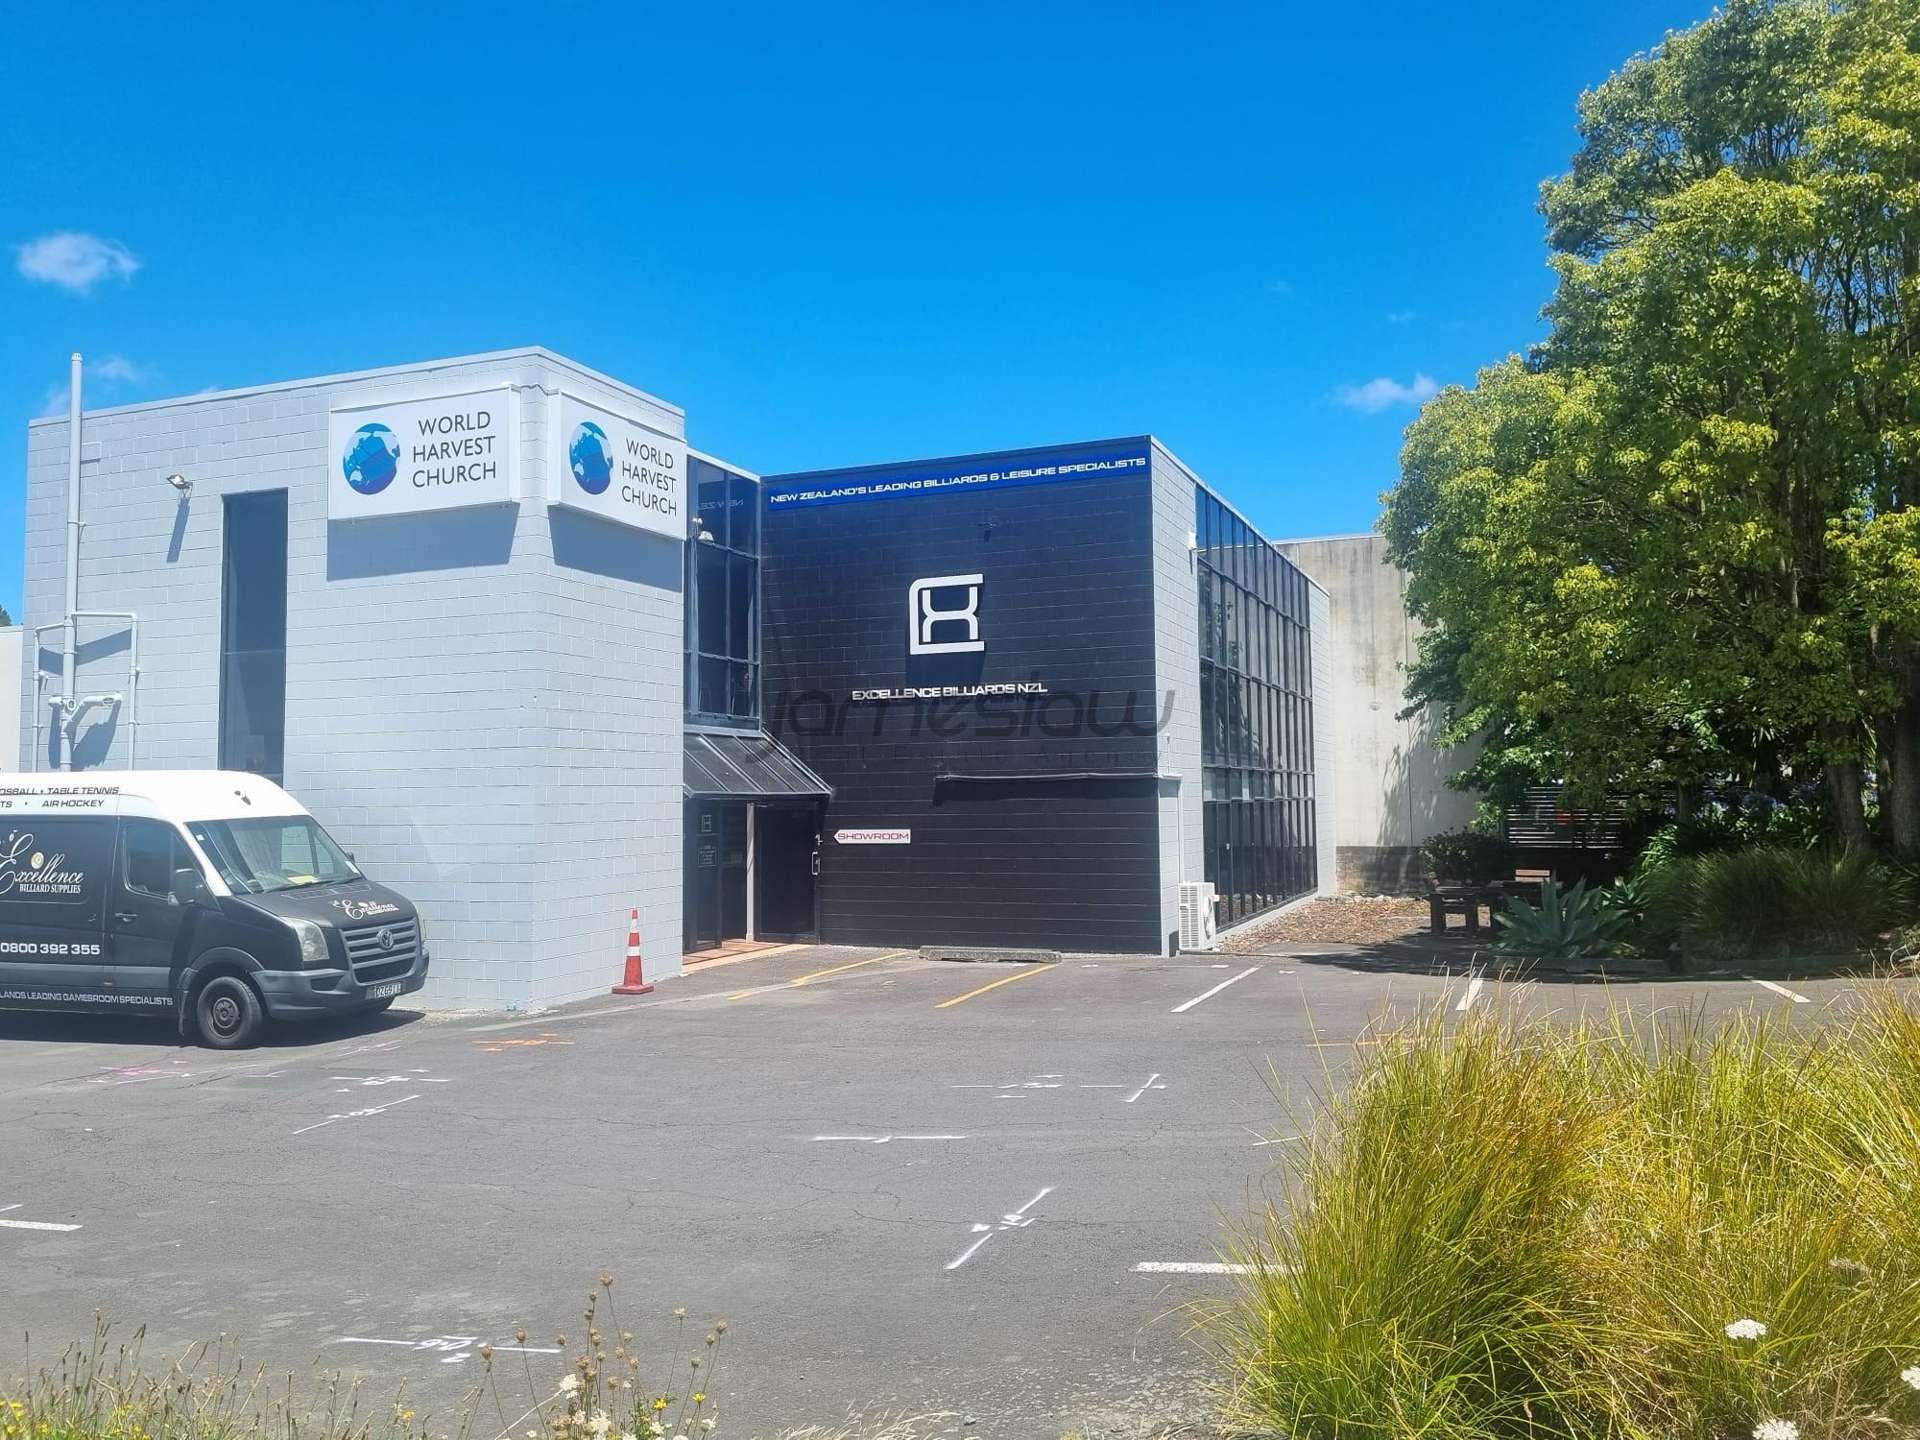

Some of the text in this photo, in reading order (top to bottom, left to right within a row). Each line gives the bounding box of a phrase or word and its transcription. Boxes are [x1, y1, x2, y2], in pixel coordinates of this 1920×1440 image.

[418, 411, 491, 436] WORLD
[413, 435, 496, 464] HARVEST
[625, 437, 674, 470] WORLD
[412, 461, 496, 489] CHURCH
[621, 460, 676, 493] HARVEST
[770, 492, 797, 504] NEW
[799, 485, 867, 501] ZEALAND'S
[867, 480, 922, 495] LEADING
[922, 473, 988, 489] BILLIARDS
[1001, 466, 1057, 481] LEISURE
[1058, 457, 1146, 475] SPECIALISTS
[621, 485, 677, 517] CHURCH
[851, 682, 1048, 702] EXCELLENCE BILLIARDS NZL
[47, 787, 79, 795] TABLE
[82, 786, 120, 795] TENNIS
[41, 800, 60, 808] AIR
[60, 799, 105, 808] HOCKEY
[837, 831, 910, 841] SHOWROOM
[19, 884, 81, 894] BILLIARD SUPPLIES
[0, 942, 101, 955] 0800 392 355
[0, 990, 174, 1006] LANDS LEADING GAMESROOM SPECIALISTS
